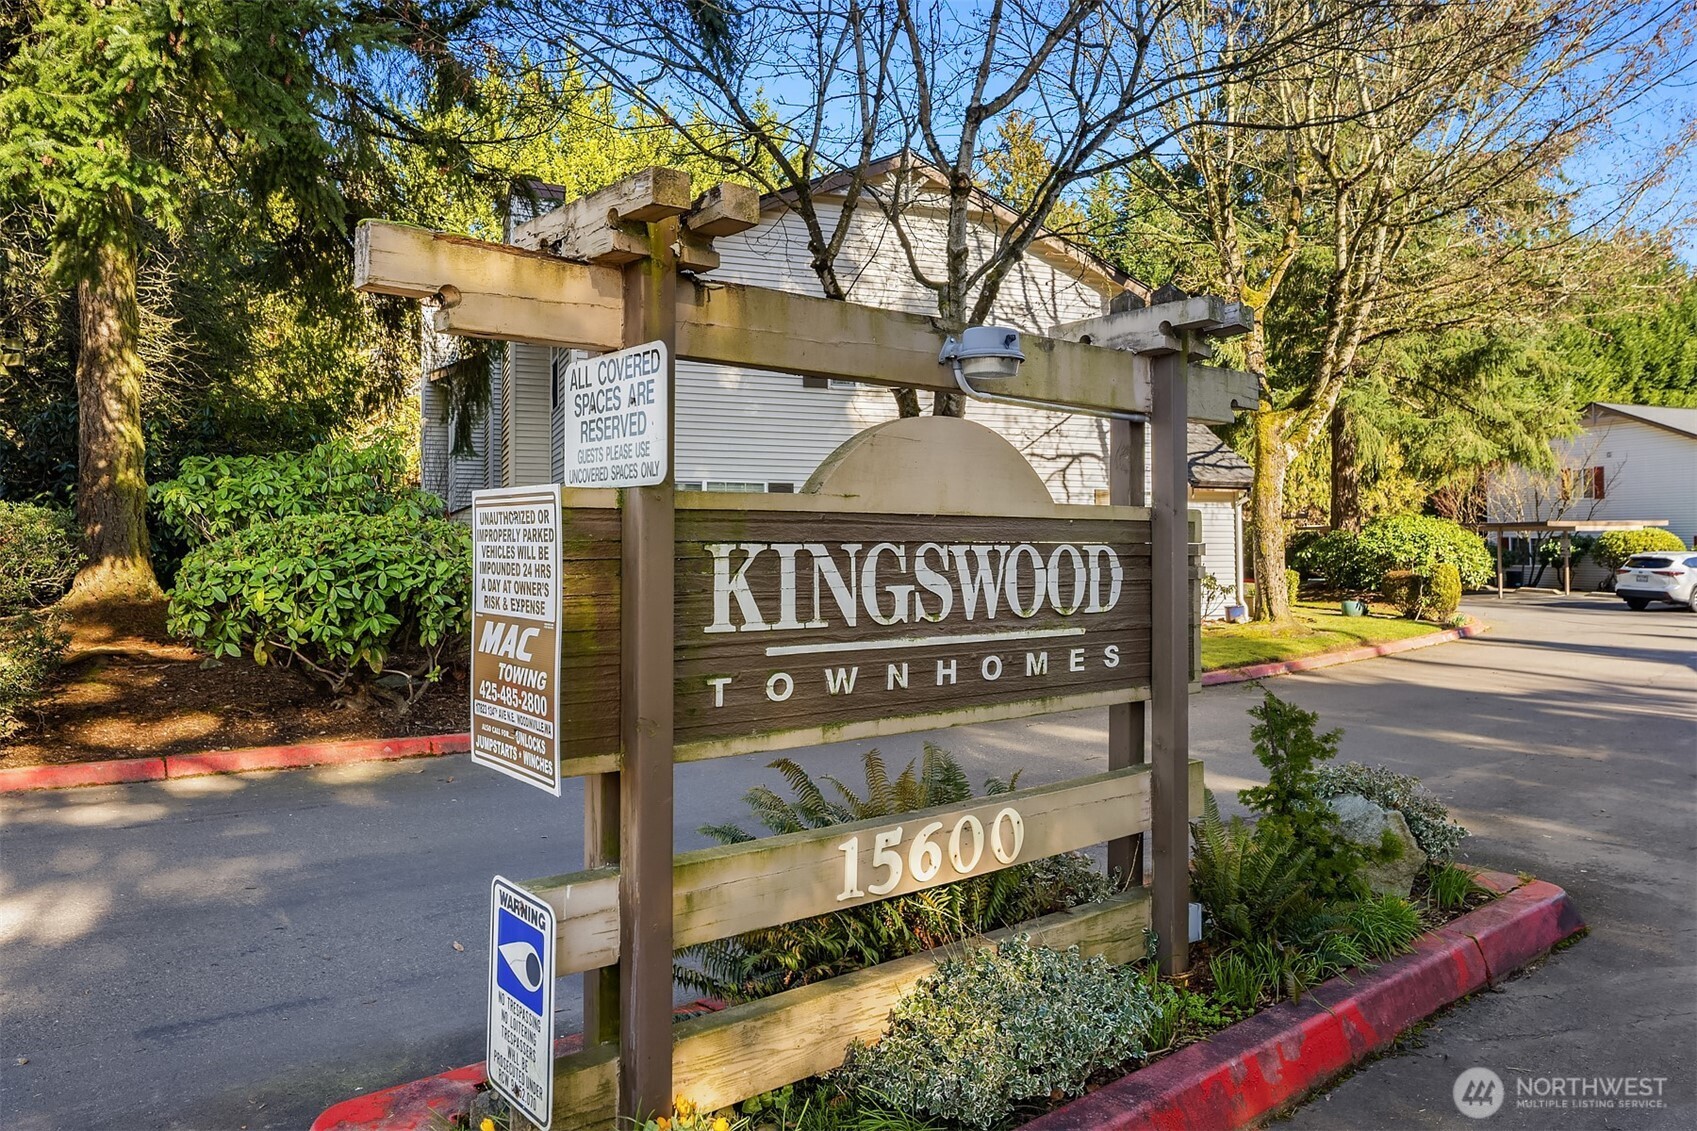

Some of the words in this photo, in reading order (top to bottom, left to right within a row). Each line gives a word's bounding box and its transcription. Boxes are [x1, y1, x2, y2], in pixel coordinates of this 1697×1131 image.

[570, 365, 592, 391] ALL
[598, 349, 661, 386] COVERED
[574, 386, 621, 418] SPACES
[627, 379, 655, 408] ARE
[580, 411, 647, 443] RESERVED
[578, 446, 603, 464] GUESTS
[606, 443, 632, 461] PLEASE
[635, 441, 650, 458] USE
[569, 467, 608, 484] UNCOVERED
[611, 463, 638, 480] SPACES
[641, 461, 660, 478] ONLY
[477, 528, 521, 542] IMPROPERLY
[522, 528, 554, 542] PARKED
[480, 510, 535, 525] UNAUTHORIZED
[537, 509, 550, 524] OR
[480, 561, 521, 577] IMPOUNDED
[522, 563, 532, 577] 24
[534, 563, 551, 579] HRS
[481, 545, 515, 559] VEHICLES
[517, 545, 536, 560] WILL
[538, 546, 549, 560] BE
[481, 578, 486, 592] A
[487, 579, 501, 593] DAY
[503, 580, 512, 594] AT
[513, 582, 549, 597] OWNER'S
[483, 595, 501, 610] RISK
[502, 597, 508, 611] &
[510, 598, 546, 616] EXPENSE
[704, 542, 1124, 633] KINGSWOOD
[478, 621, 540, 662] MAC
[498, 662, 547, 691] TOWING
[707, 645, 1120, 708] TOWNHOMES
[479, 680, 547, 717] 425-485-2800
[476, 734, 517, 760] JUMPSTARTS
[523, 750, 553, 776] WINCHES
[492, 726, 500, 735] CALL
[515, 730, 546, 754] UNLOCKS
[836, 807, 1025, 901] 15600
[499, 889, 546, 931] WARNING
[498, 990, 505, 1005] NO
[507, 996, 541, 1033] TRESPASSING
[501, 1009, 508, 1024] NO
[510, 1015, 537, 1046] LOITERING
[501, 1024, 536, 1063] TRESPASSERS
[507, 1045, 519, 1066] WILL
[522, 1056, 528, 1073] BE
[494, 1049, 525, 1086] PROSECUTED
[526, 1075, 543, 1101] UNDER
